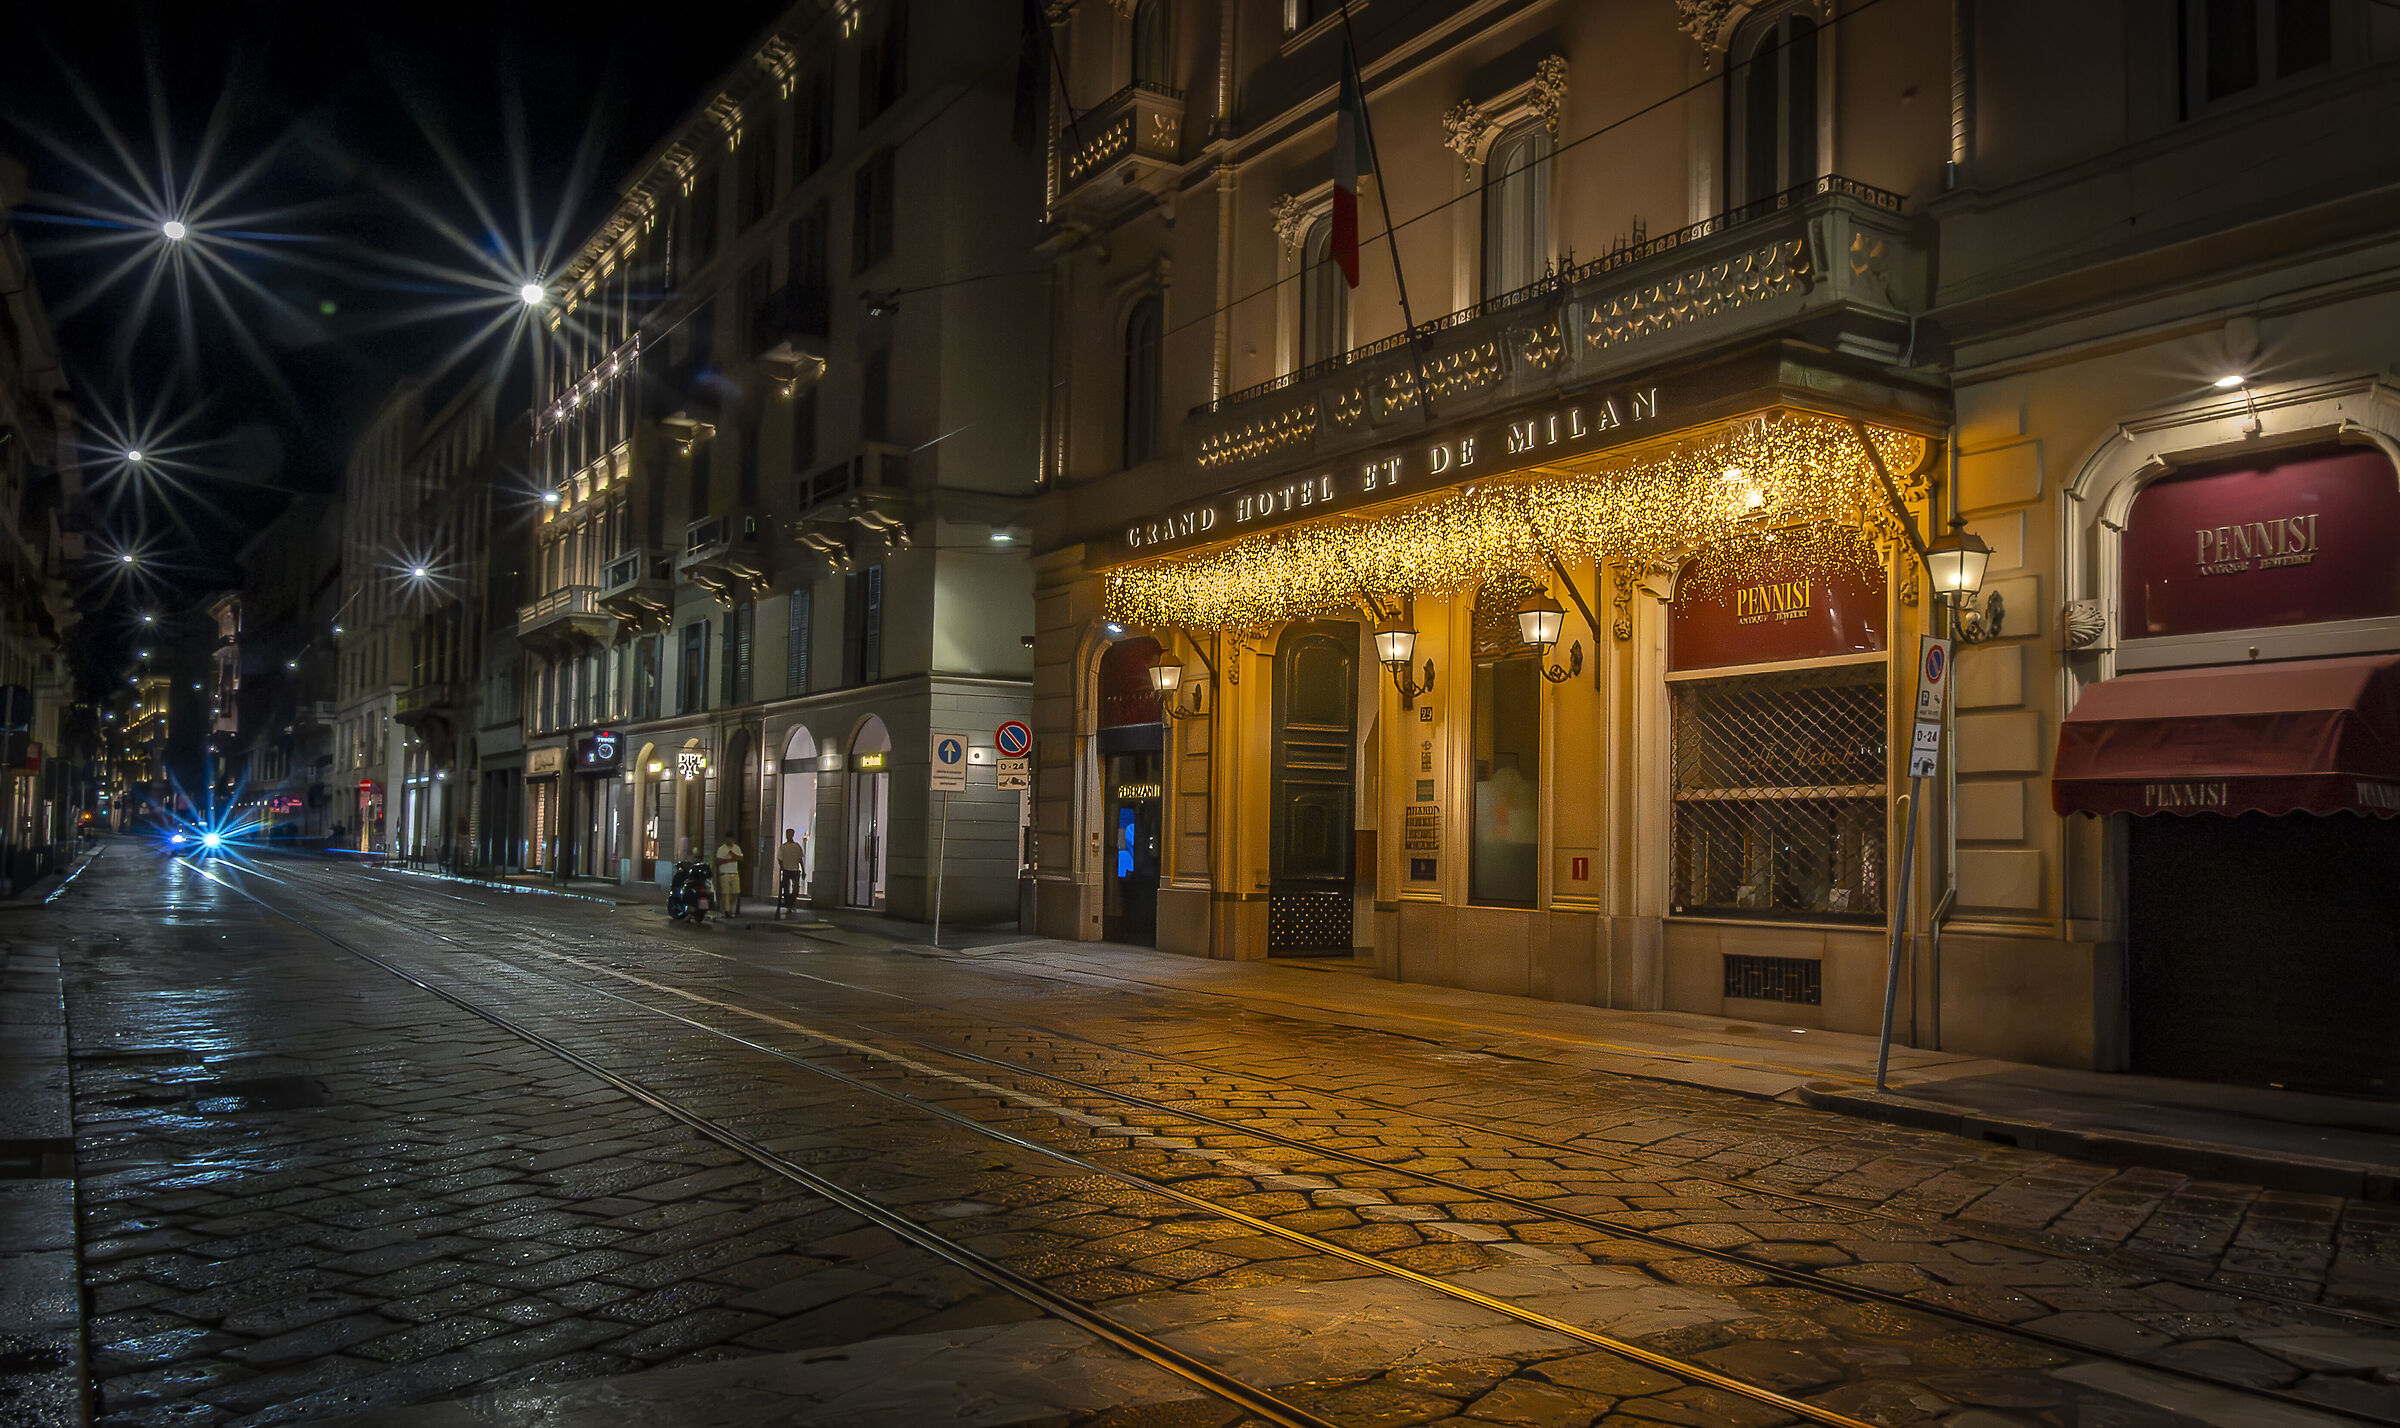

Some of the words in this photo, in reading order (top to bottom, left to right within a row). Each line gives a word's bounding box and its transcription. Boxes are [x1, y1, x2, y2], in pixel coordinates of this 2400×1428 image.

[1127, 507, 1215, 548] GRAND
[1236, 474, 1333, 523] HOTEL
[1363, 457, 1401, 492] ET
[1430, 437, 1474, 475] DE
[1508, 387, 1657, 455] MILAN
[2195, 513, 2320, 566] PENNISI
[1736, 579, 1811, 617] PENNISI
[1421, 708, 1432, 720] 29
[2145, 782, 2228, 807] PENNISI
